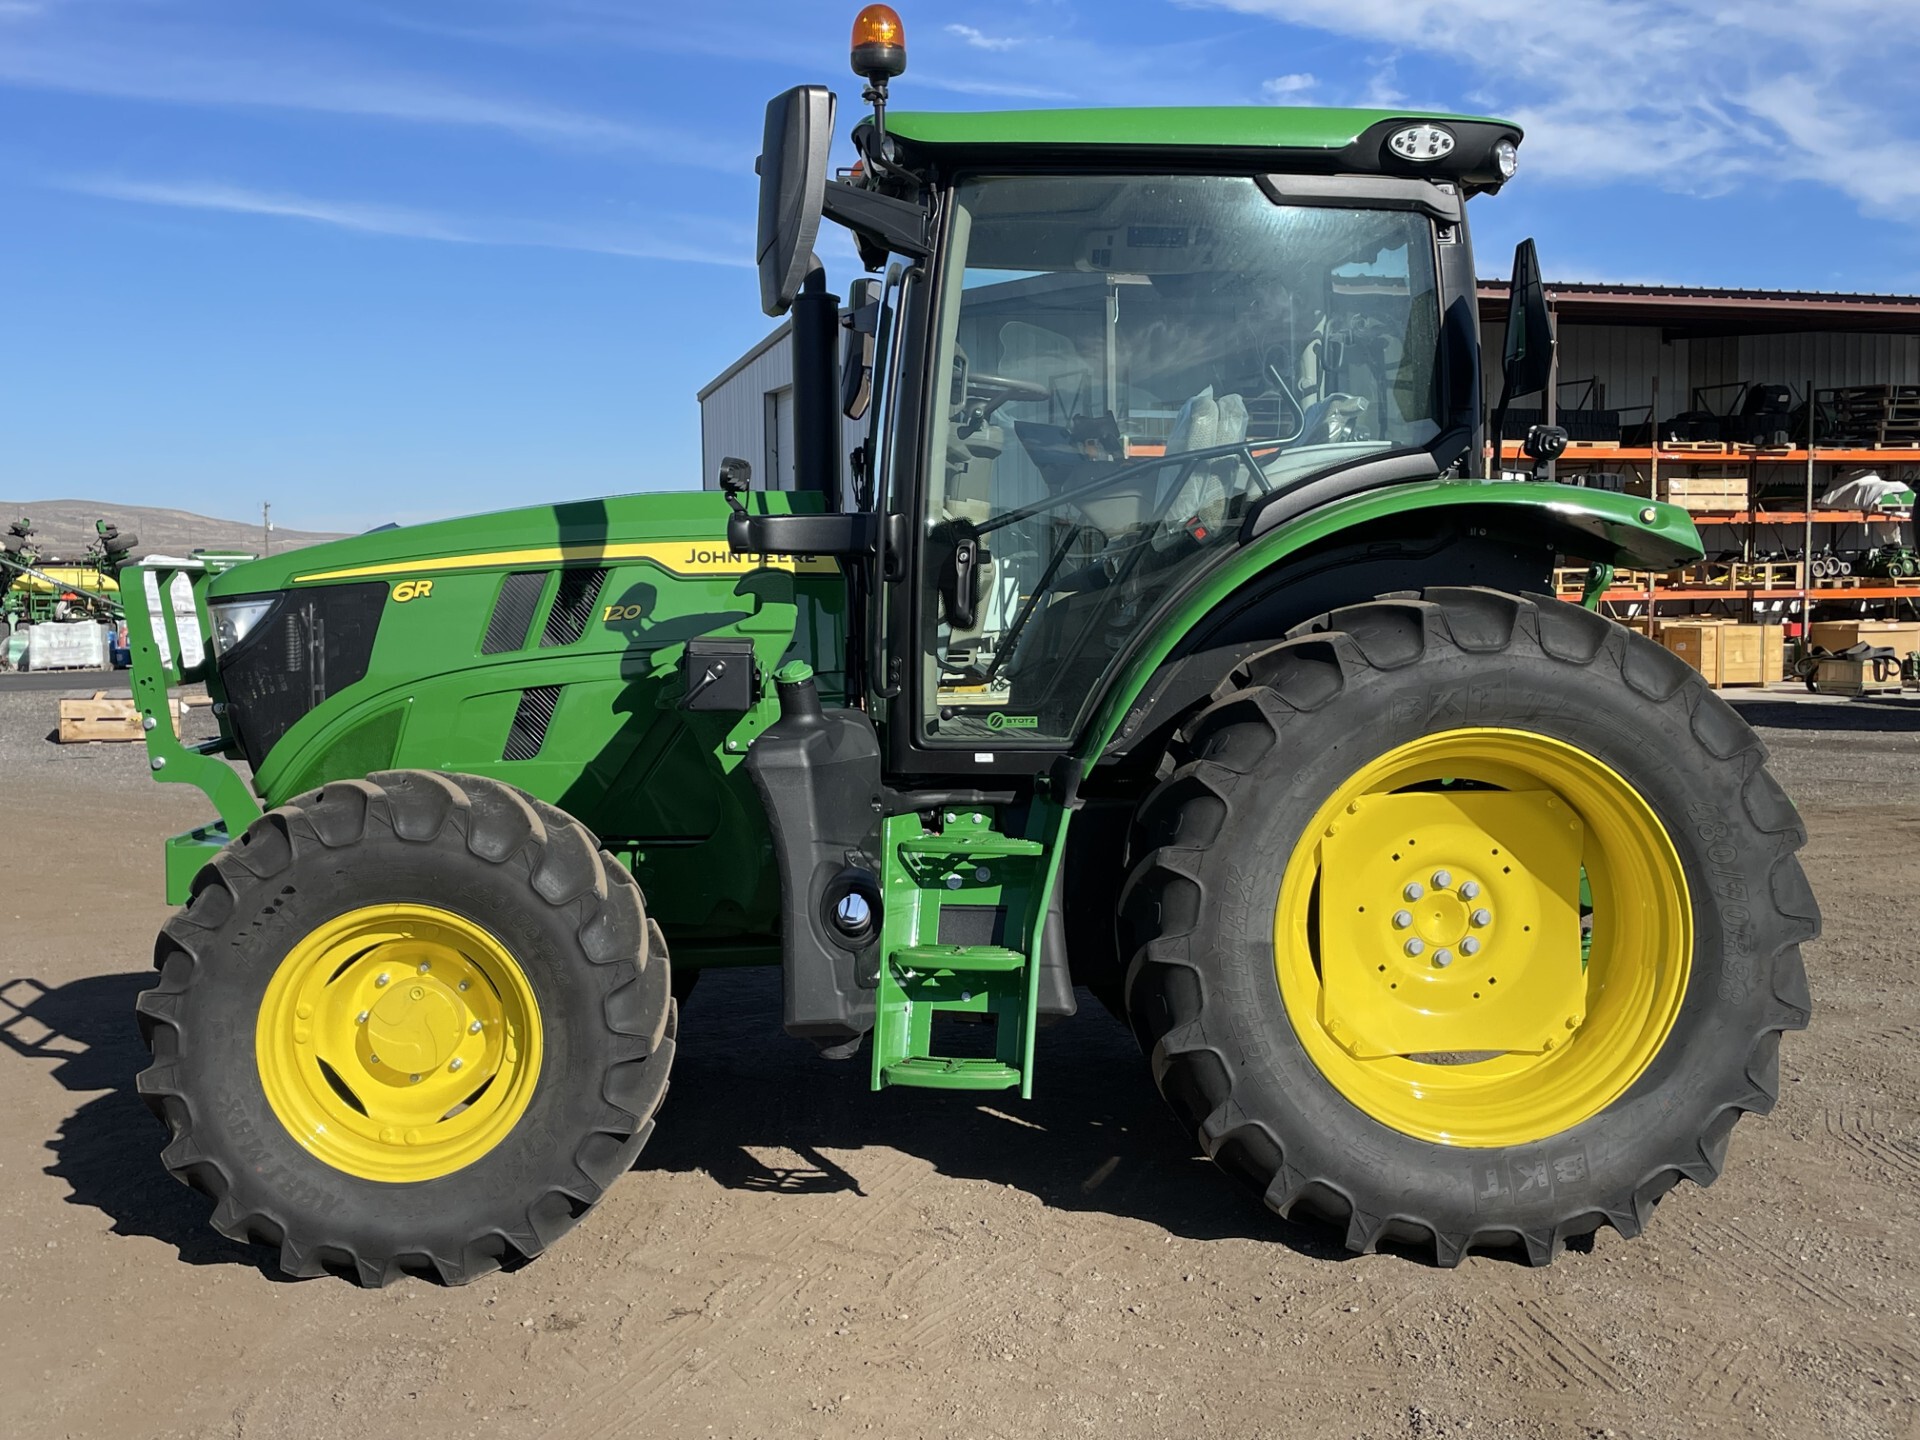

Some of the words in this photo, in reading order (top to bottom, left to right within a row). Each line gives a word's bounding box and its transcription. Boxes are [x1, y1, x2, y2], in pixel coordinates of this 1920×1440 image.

[685, 548, 741, 564] JOHN
[391, 579, 433, 603] 6R
[602, 604, 643, 622] 120
[1479, 1152, 1587, 1201] BKT
